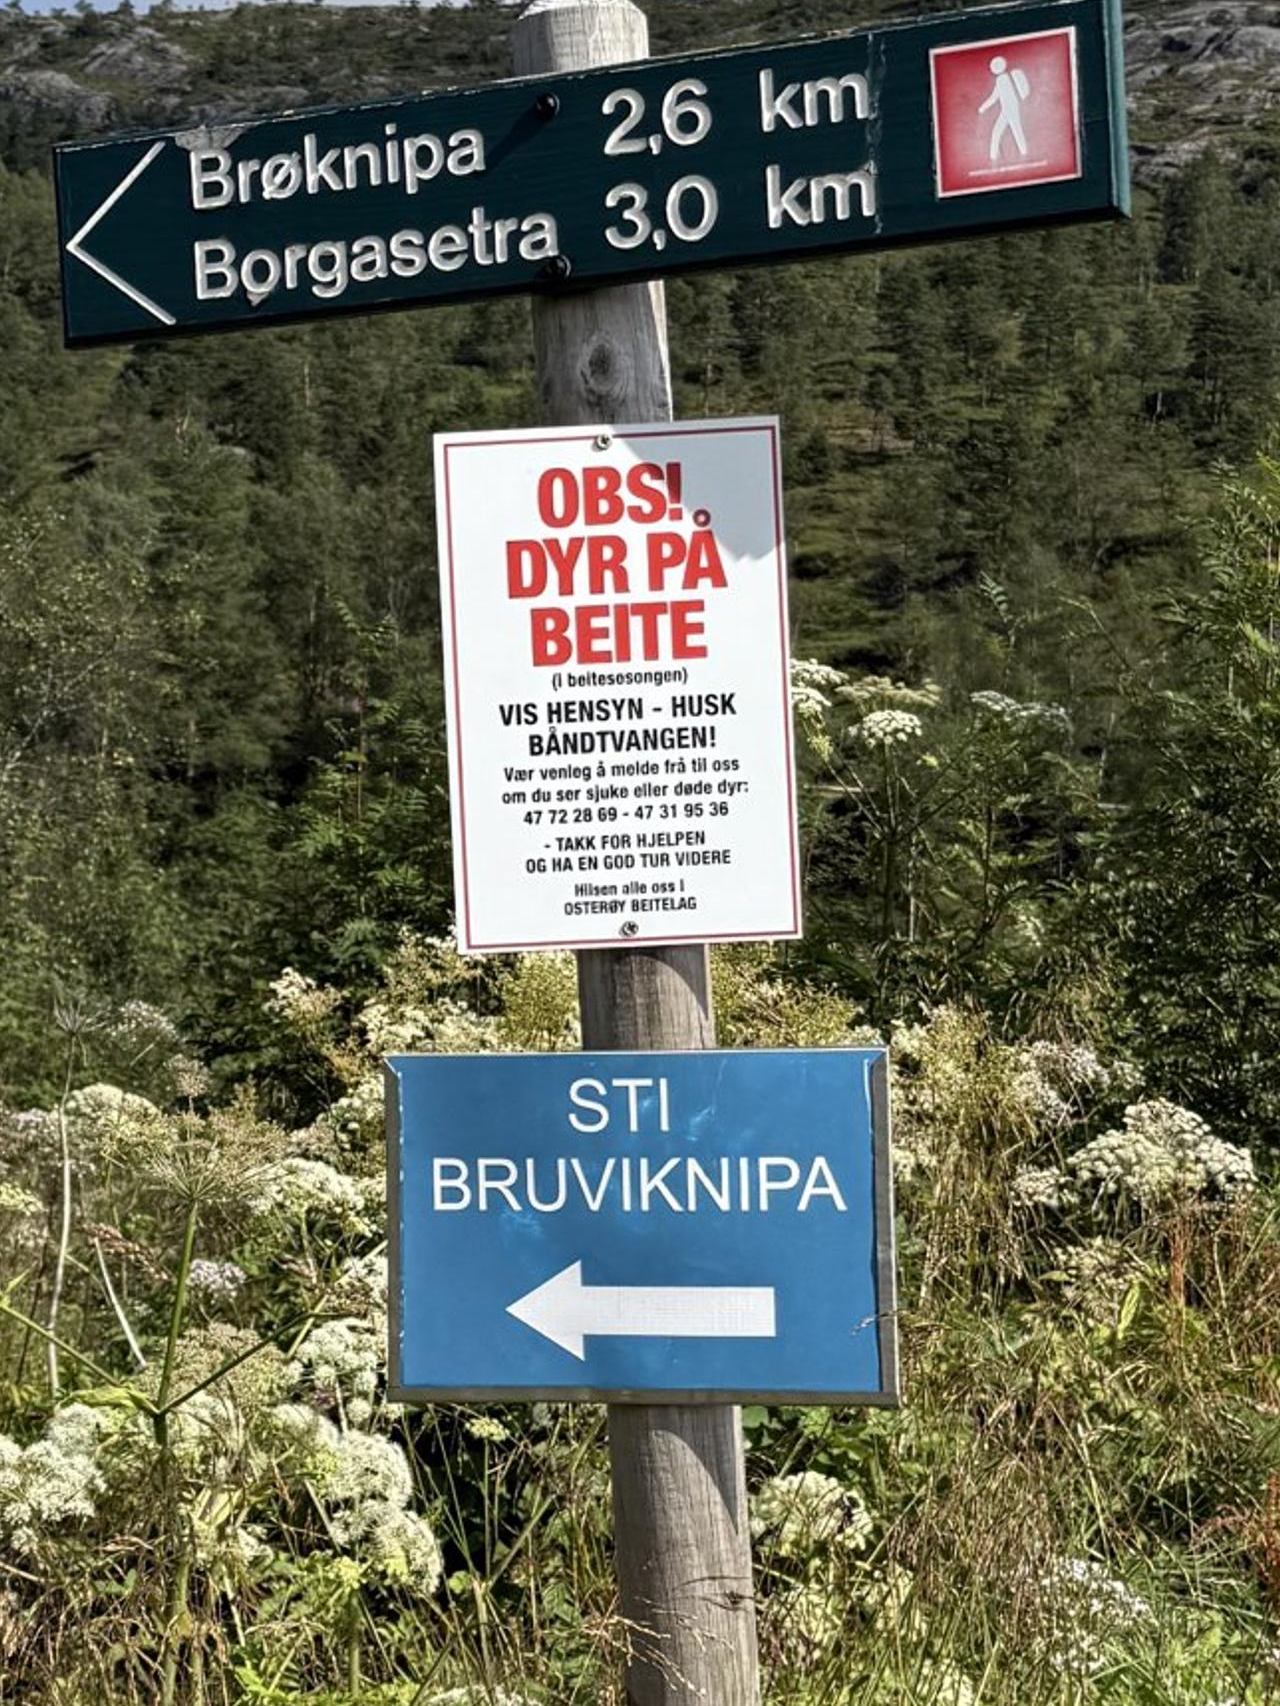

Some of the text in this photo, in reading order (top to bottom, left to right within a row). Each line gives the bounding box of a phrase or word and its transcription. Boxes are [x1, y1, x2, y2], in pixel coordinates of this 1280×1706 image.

[189, 68, 869, 210] Brøknipa 2,6 km
[194, 164, 876, 300] Borgasetra 3,0 km
[537, 461, 682, 528] OBS!
[505, 508, 729, 600] DYR PÅ
[530, 599, 708, 667] BEITE
[498, 702, 539, 727] VIS
[546, 697, 644, 725] HENSYN
[671, 692, 737, 718] HUSK
[528, 725, 716, 757] BÅNDTVANGEN!
[503, 757, 740, 782] Vær venleg å melde frå til oss
[502, 779, 749, 805] om du ser sjuke eller døde dyr:
[523, 810, 543, 825] 47
[548, 808, 568, 825] 72
[572, 807, 593, 823] 28
[634, 804, 654, 820] 47
[659, 803, 677, 819] 31
[683, 802, 704, 818] 95
[709, 801, 729, 817] 36
[555, 835, 596, 852] TAKK
[601, 834, 632, 850] FOR
[636, 830, 705, 848] HJELPEN
[526, 849, 731, 874] OG HA EN GOD TUR VIDERE
[574, 883, 618, 897] Hilsen
[622, 881, 647, 895] alle
[651, 882, 676, 894] oss
[564, 896, 697, 916] OSTERØY BEITELAG
[568, 1078, 670, 1133] STI
[431, 1155, 848, 1213] BRUVIKNIPA
